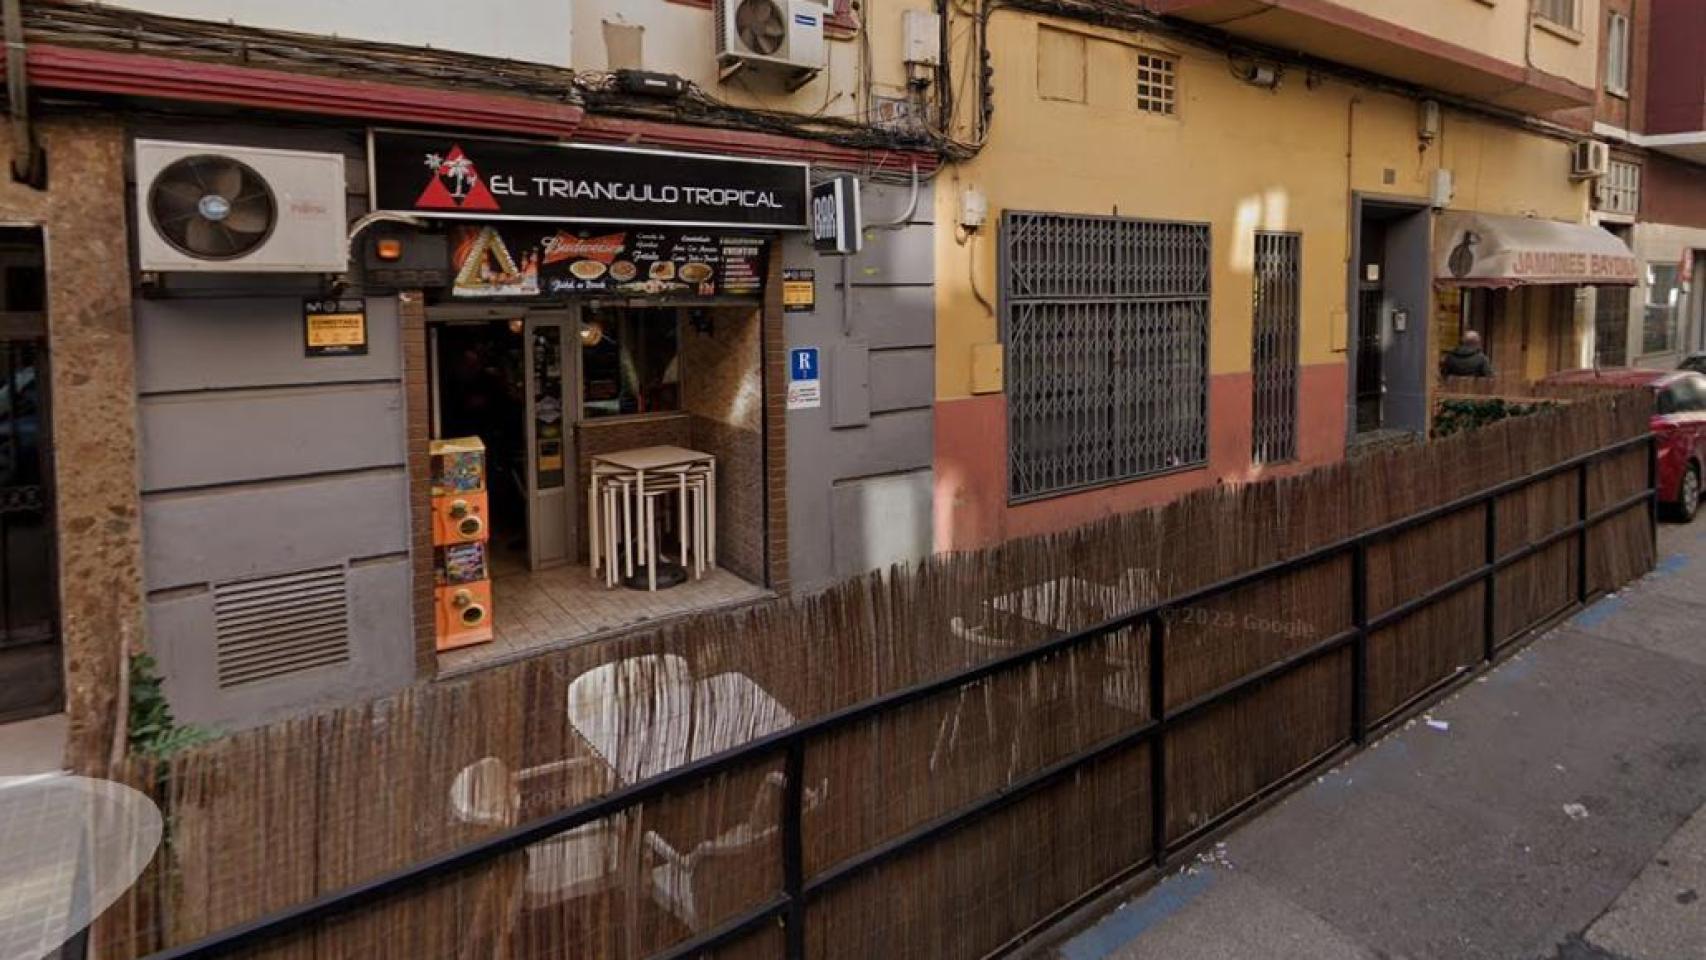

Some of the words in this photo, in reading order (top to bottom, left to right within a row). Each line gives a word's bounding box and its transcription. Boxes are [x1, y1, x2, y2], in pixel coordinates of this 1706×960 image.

[490, 175, 529, 196] EL
[531, 177, 679, 204] TRIANGULO
[681, 186, 783, 209] TROPICAL
[814, 194, 836, 241] BAR
[1512, 252, 1586, 275] JAMONES
[797, 352, 811, 370] R
